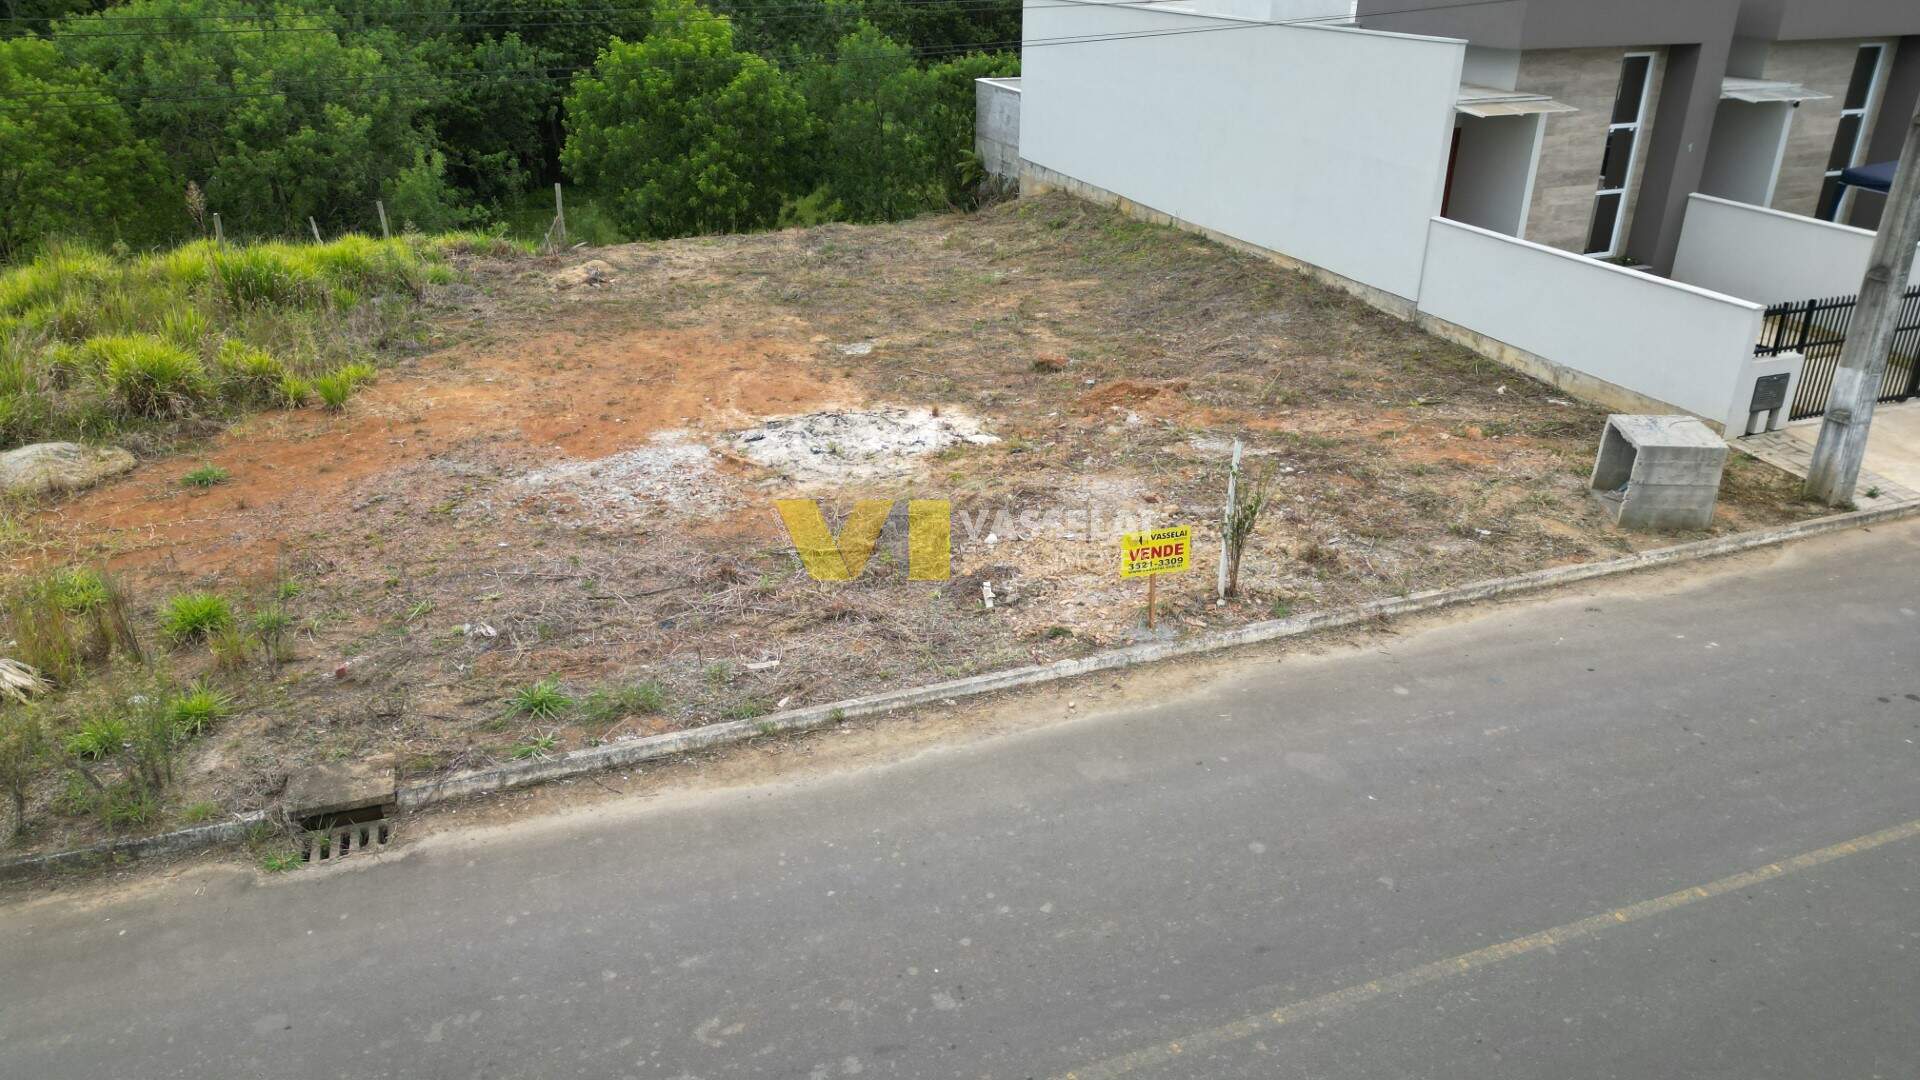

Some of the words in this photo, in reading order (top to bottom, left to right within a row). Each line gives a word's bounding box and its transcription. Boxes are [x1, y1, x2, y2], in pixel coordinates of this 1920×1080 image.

[1150, 530, 1187, 541] VASSELAI
[1129, 543, 1184, 561] VENDE
[1128, 557, 1184, 570] 3521-3309
